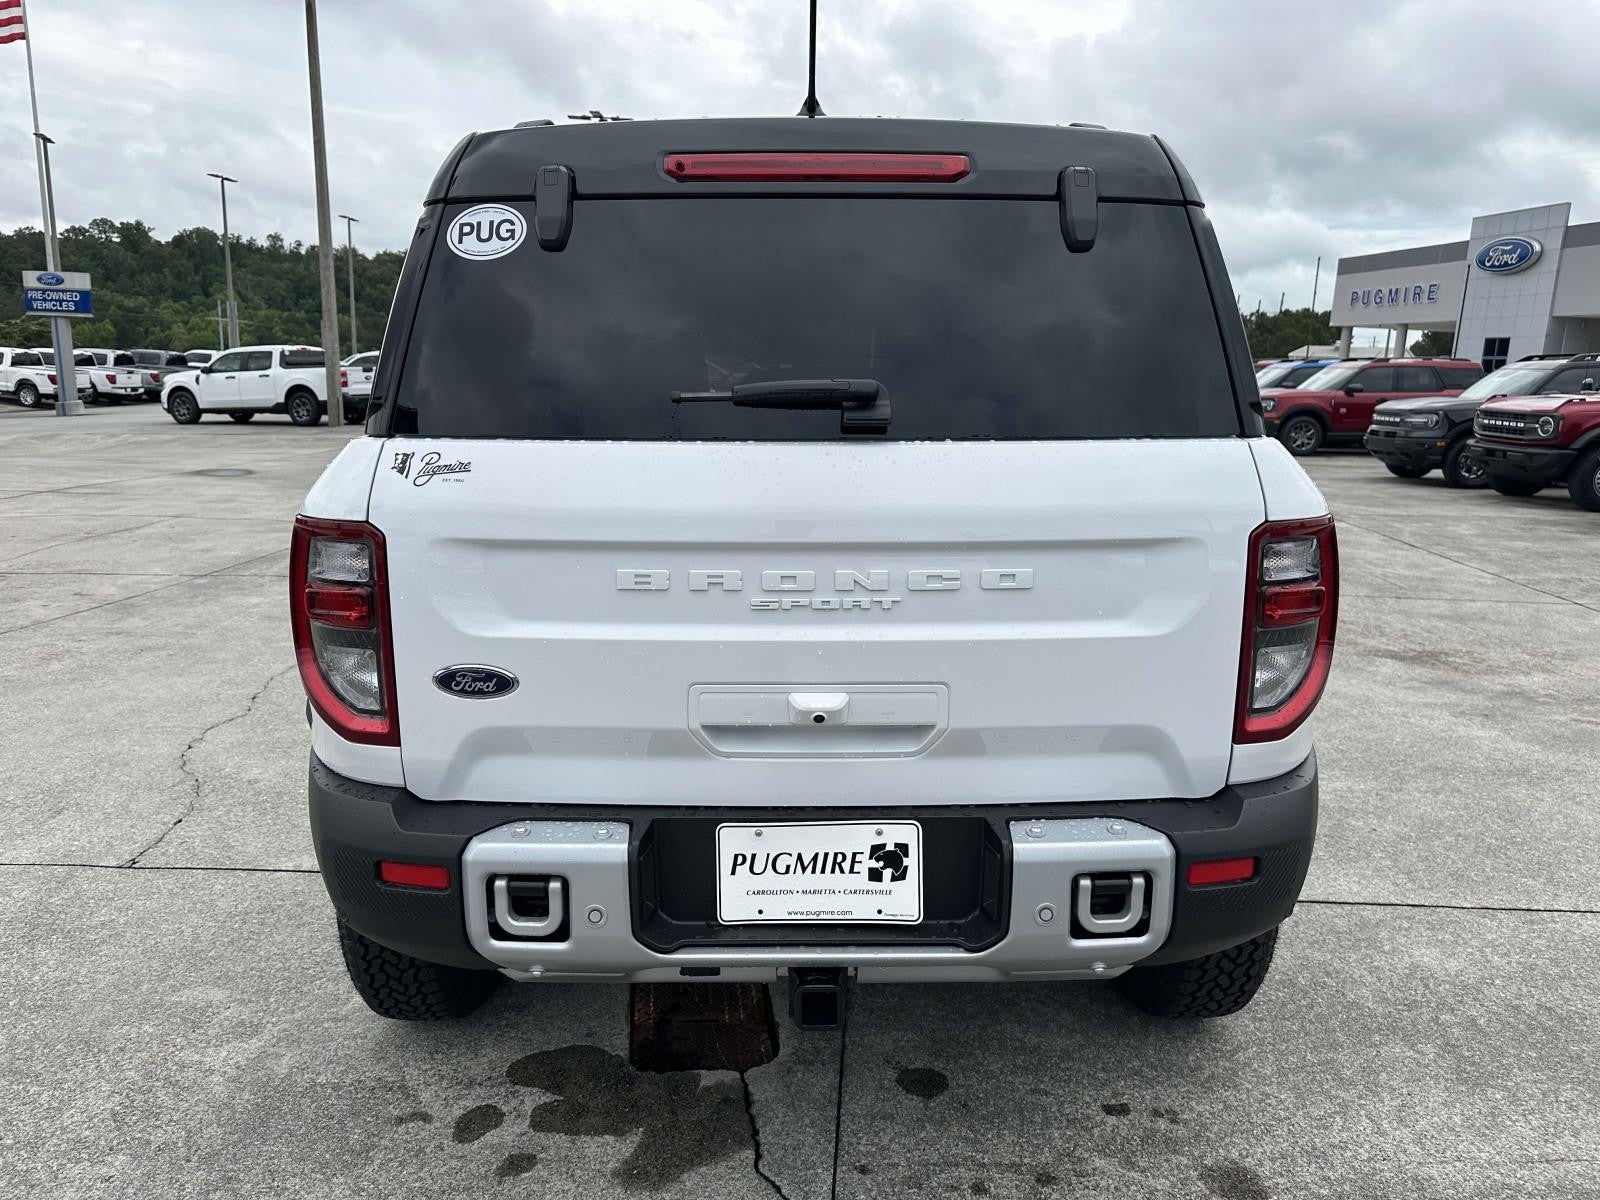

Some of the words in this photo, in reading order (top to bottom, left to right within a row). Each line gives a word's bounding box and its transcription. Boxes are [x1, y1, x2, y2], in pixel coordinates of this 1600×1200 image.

[458, 218, 516, 245] PUG
[1485, 245, 1521, 267] Ford
[28, 290, 80, 301] PRE-OWNED
[1351, 283, 1439, 306] PUGMIRE
[32, 301, 76, 311] VEHICLES
[413, 451, 472, 487] Pugmire
[616, 568, 1035, 591] BRONCO
[750, 598, 901, 610] SPORT
[451, 671, 497, 692] Ford
[730, 851, 865, 876] PUGMIRE
[746, 888, 795, 896] CARROLLTON
[800, 888, 836, 896] MARIETTA
[843, 888, 893, 896] CARTERSVILLE
[786, 908, 853, 917] www.pugmire.com
